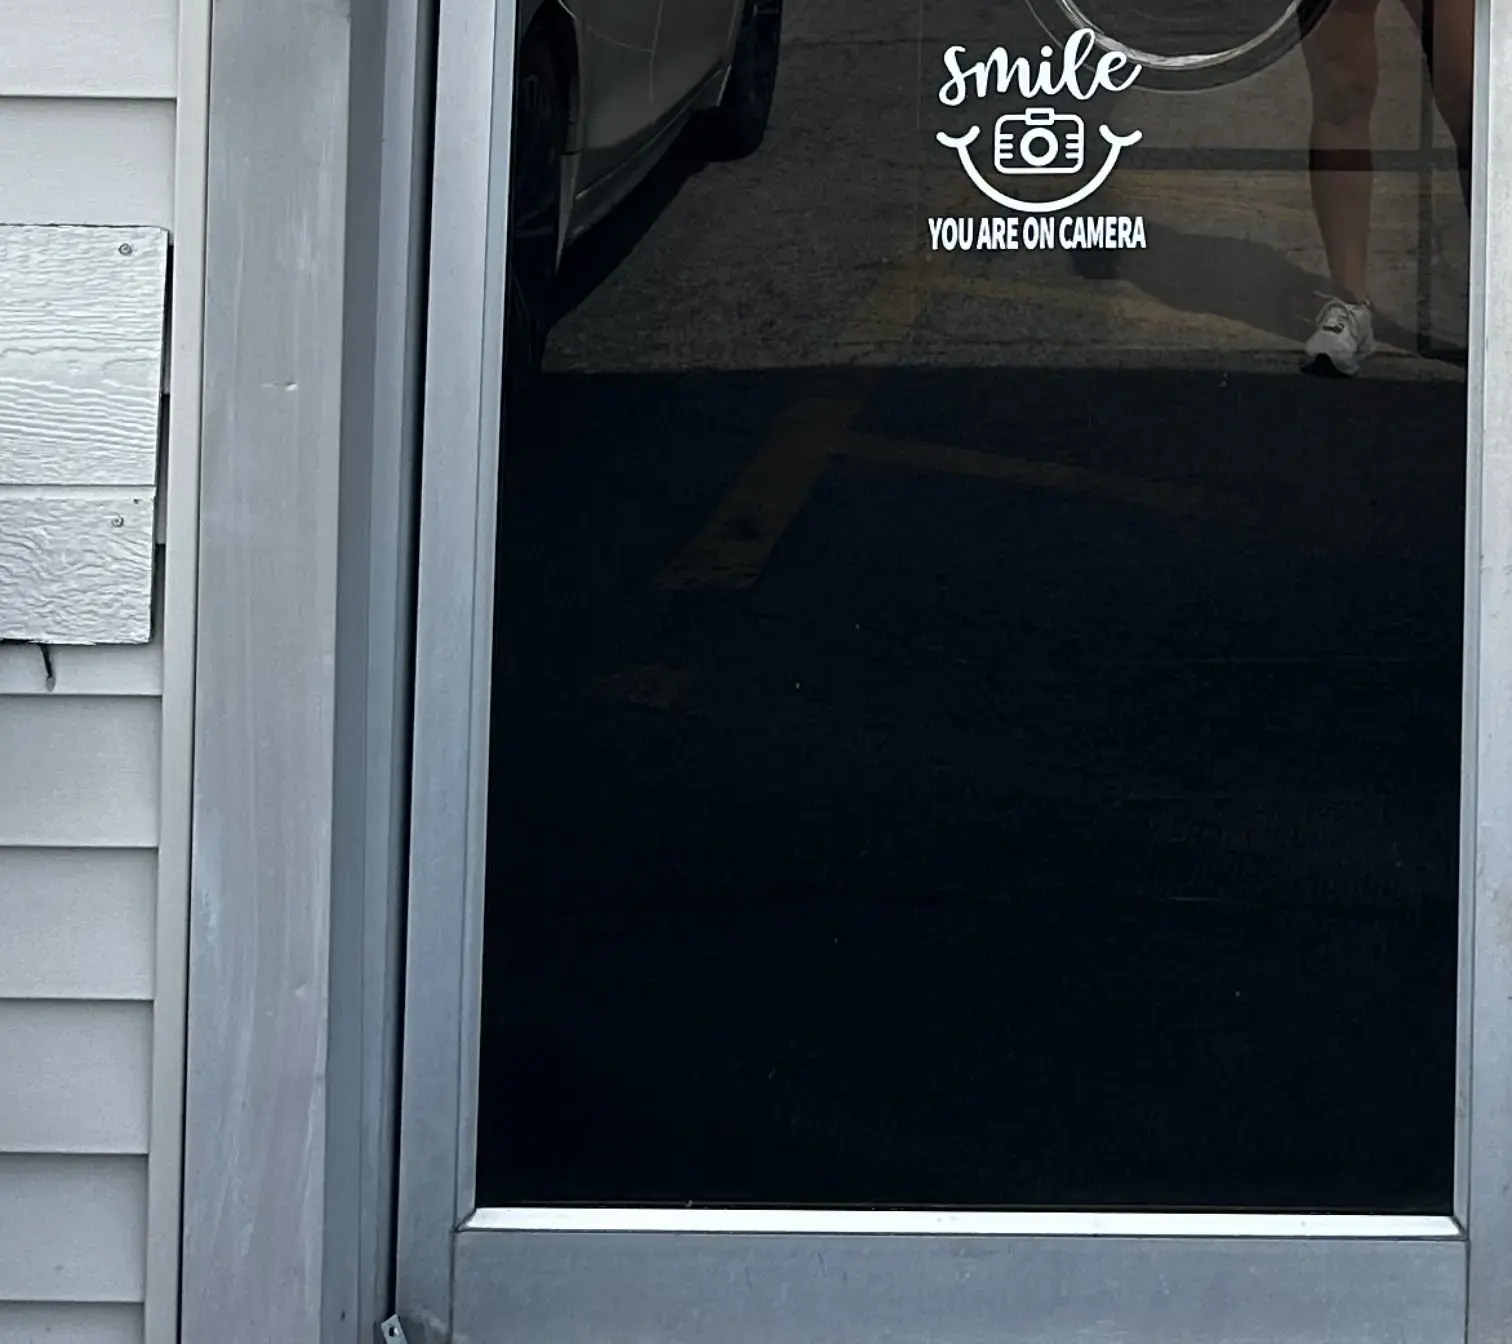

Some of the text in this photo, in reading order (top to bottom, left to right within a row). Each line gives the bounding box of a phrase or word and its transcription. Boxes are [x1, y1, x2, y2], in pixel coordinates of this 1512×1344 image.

[938, 28, 1143, 107] smile
[928, 216, 1147, 250] YOU ARE ON CAMERA
